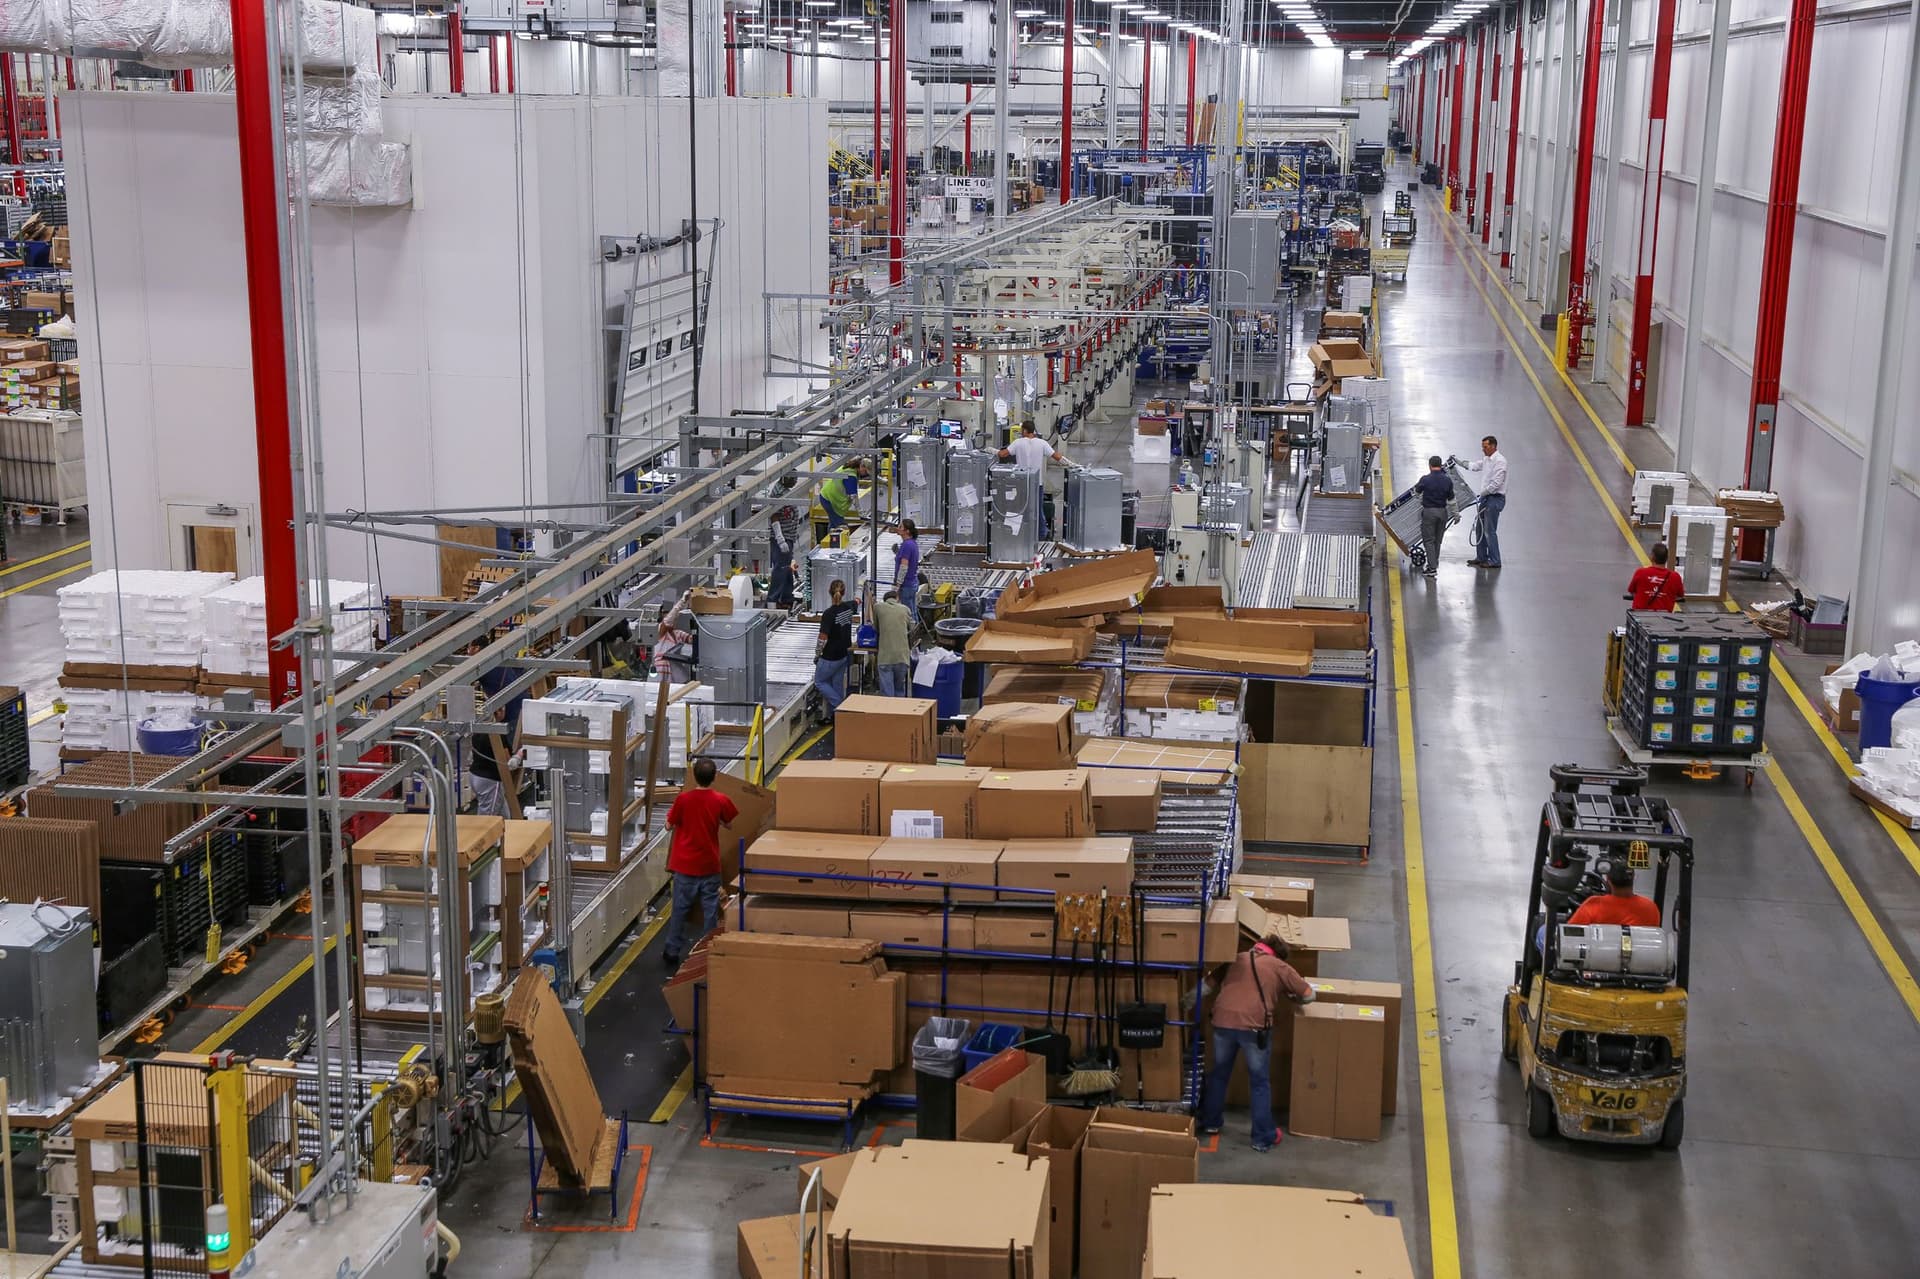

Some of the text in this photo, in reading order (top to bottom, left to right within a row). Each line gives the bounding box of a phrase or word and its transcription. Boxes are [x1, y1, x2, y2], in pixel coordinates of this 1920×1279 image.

[948, 179, 986, 187] LINE 10
[1590, 1089, 1638, 1110] Yale
